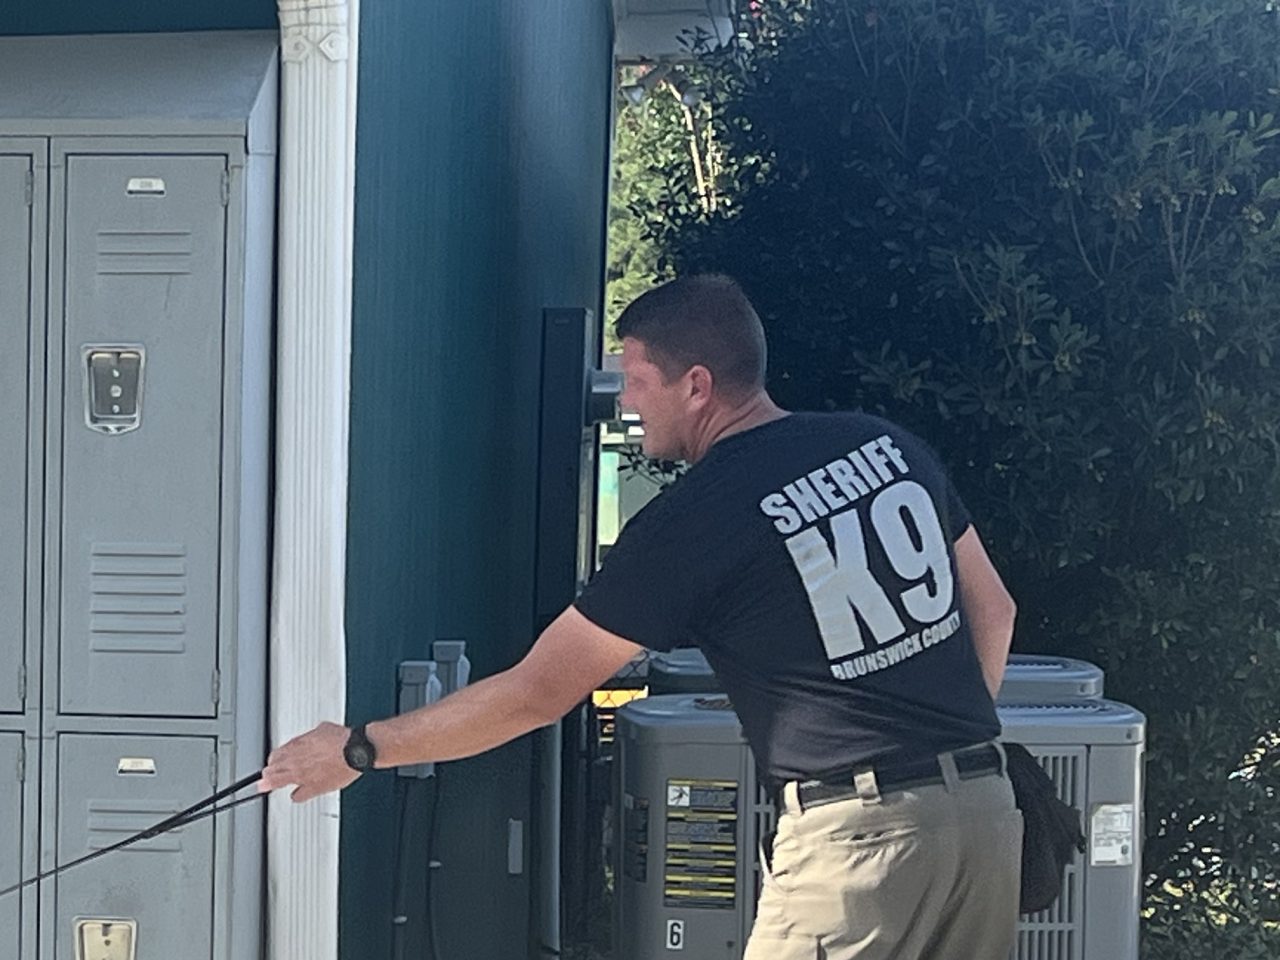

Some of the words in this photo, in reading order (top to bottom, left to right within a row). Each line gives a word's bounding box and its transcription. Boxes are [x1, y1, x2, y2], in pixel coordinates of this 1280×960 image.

[759, 434, 910, 535] SHERIFF
[784, 480, 953, 660] K9
[830, 632, 923, 680] BRUNSWICK
[669, 922, 682, 947] 6
